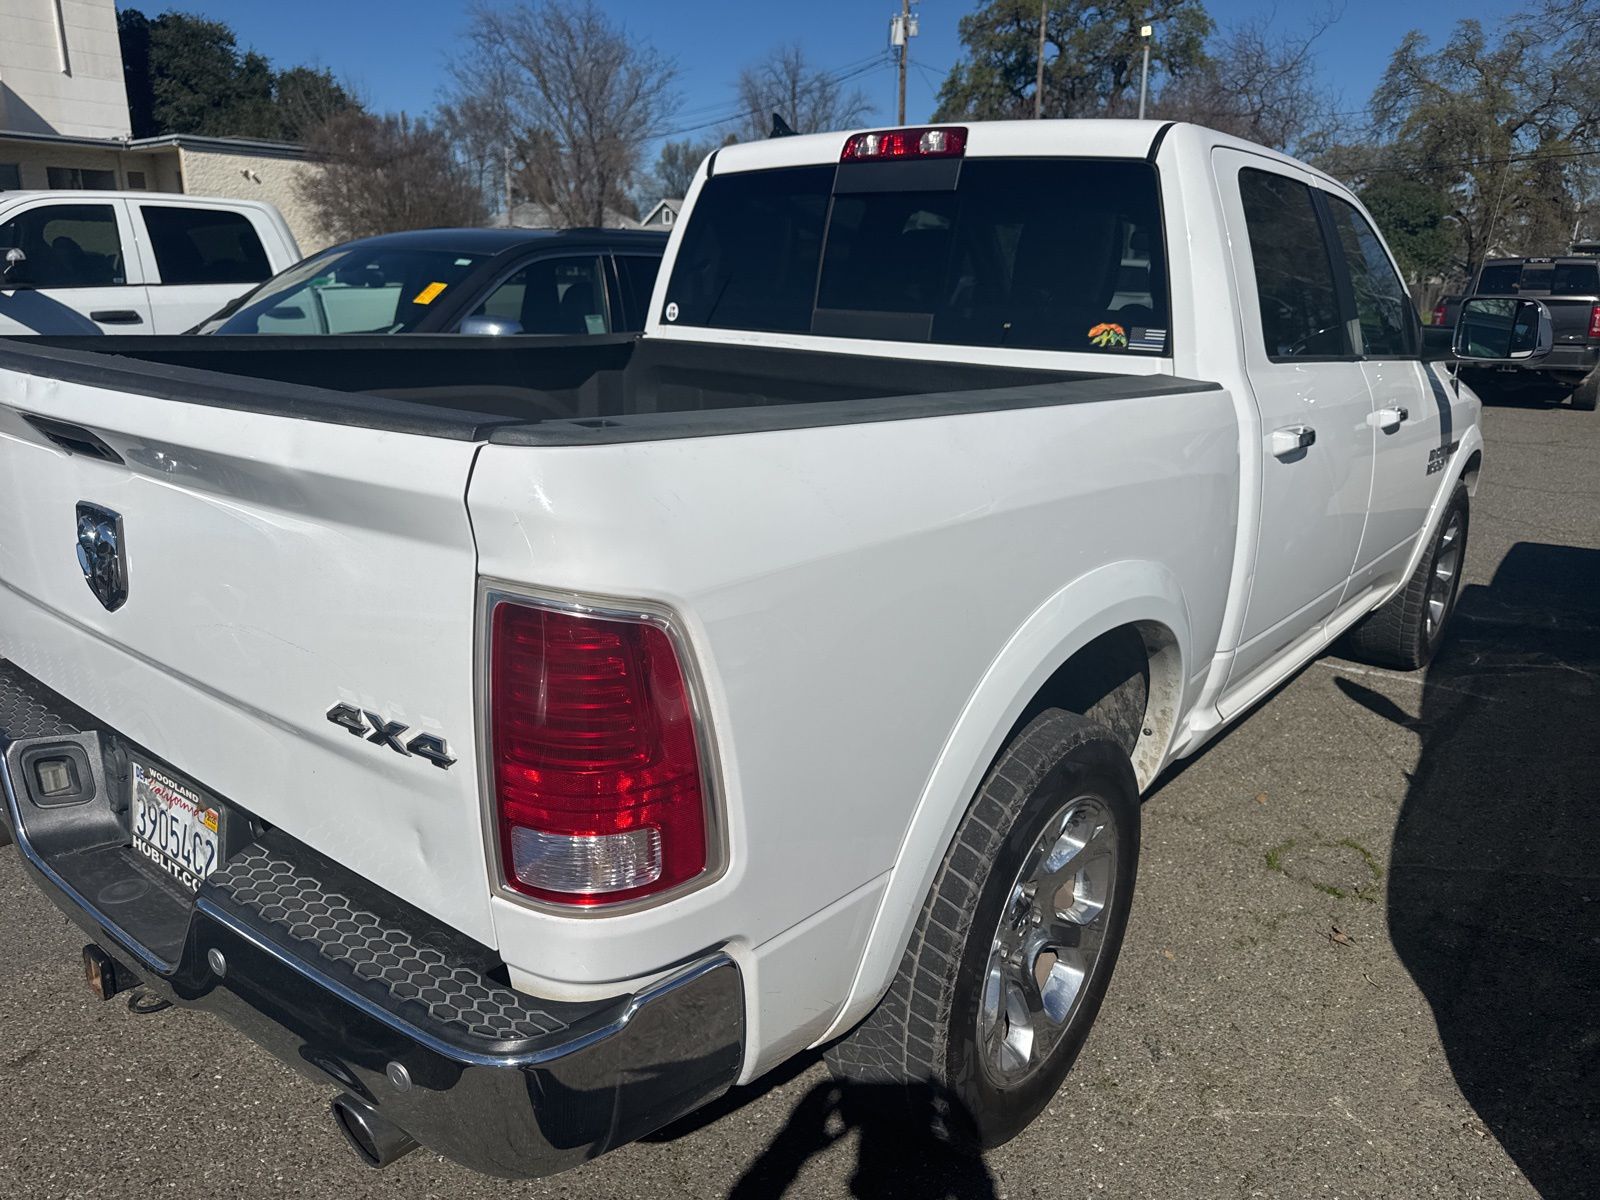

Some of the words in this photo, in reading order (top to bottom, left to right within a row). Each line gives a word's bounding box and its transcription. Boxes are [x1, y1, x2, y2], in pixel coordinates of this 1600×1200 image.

[149, 767, 199, 803] WOODLAND
[132, 835, 202, 892] HOBLIT.CO
[136, 799, 215, 879] 39054C2
